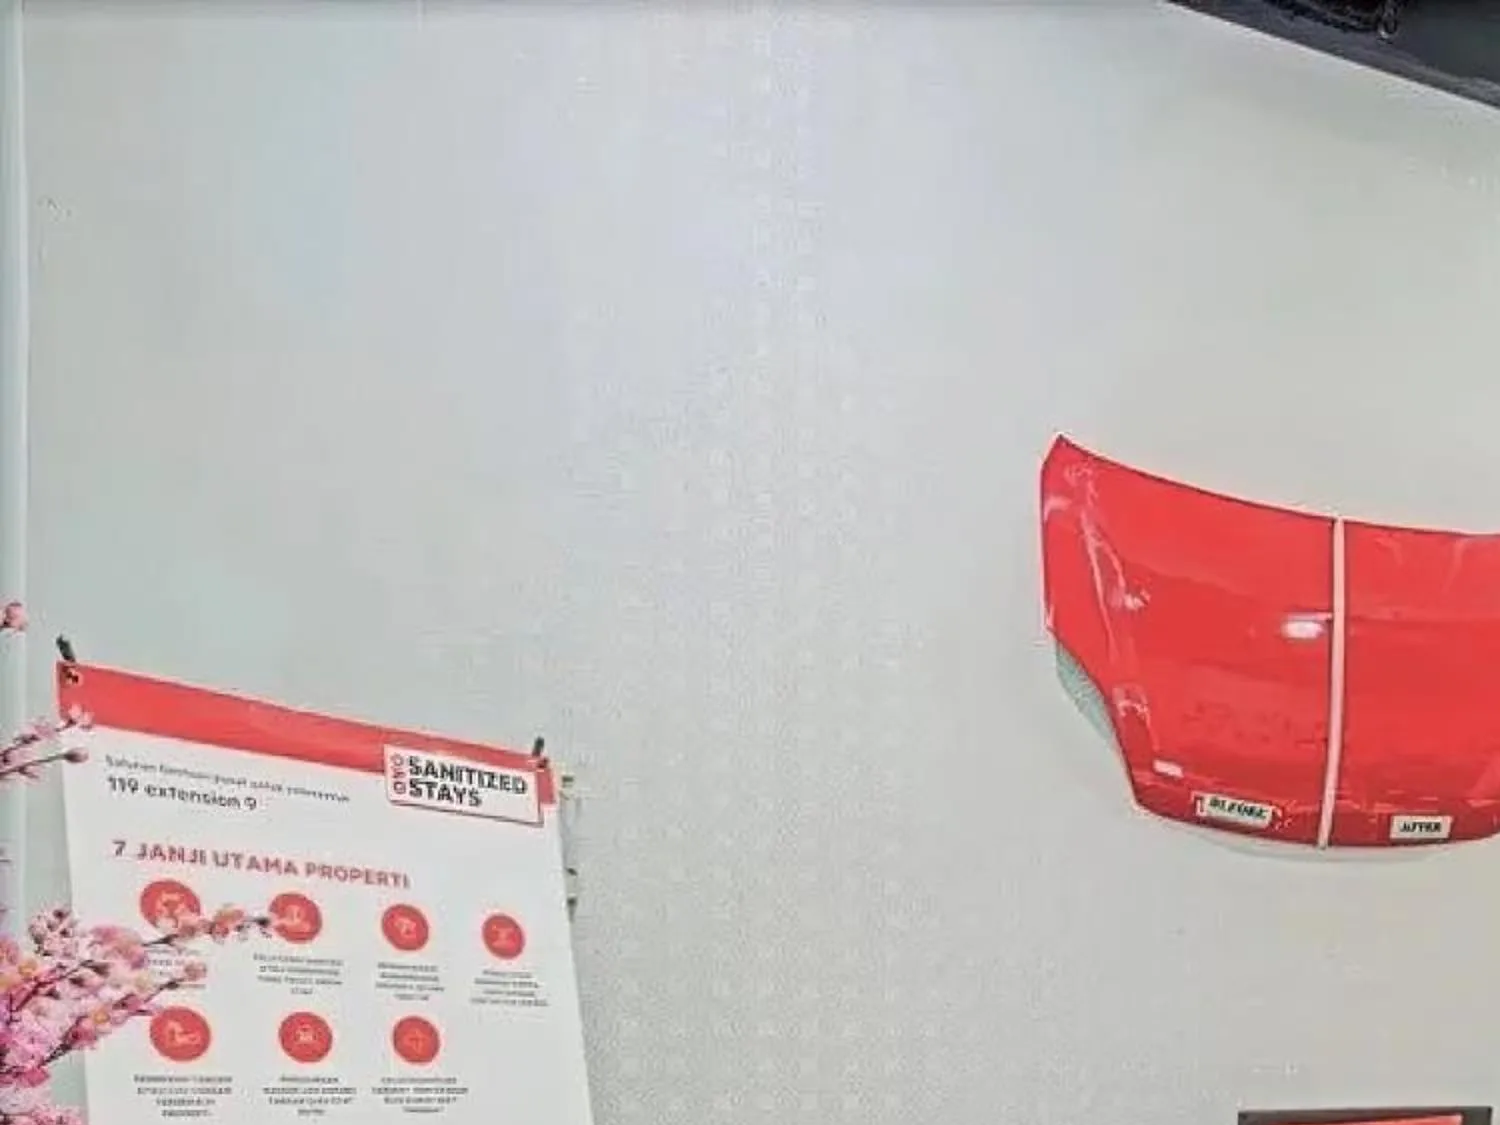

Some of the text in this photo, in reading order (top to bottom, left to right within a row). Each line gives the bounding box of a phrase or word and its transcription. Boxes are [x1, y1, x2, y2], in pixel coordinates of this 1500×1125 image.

[108, 776, 139, 795] 119
[144, 784, 241, 809] extension
[408, 755, 528, 794] SANITIZED
[409, 778, 482, 807] STAYS
[112, 840, 411, 889] 7 JANJI UTAMA PROPERTI
